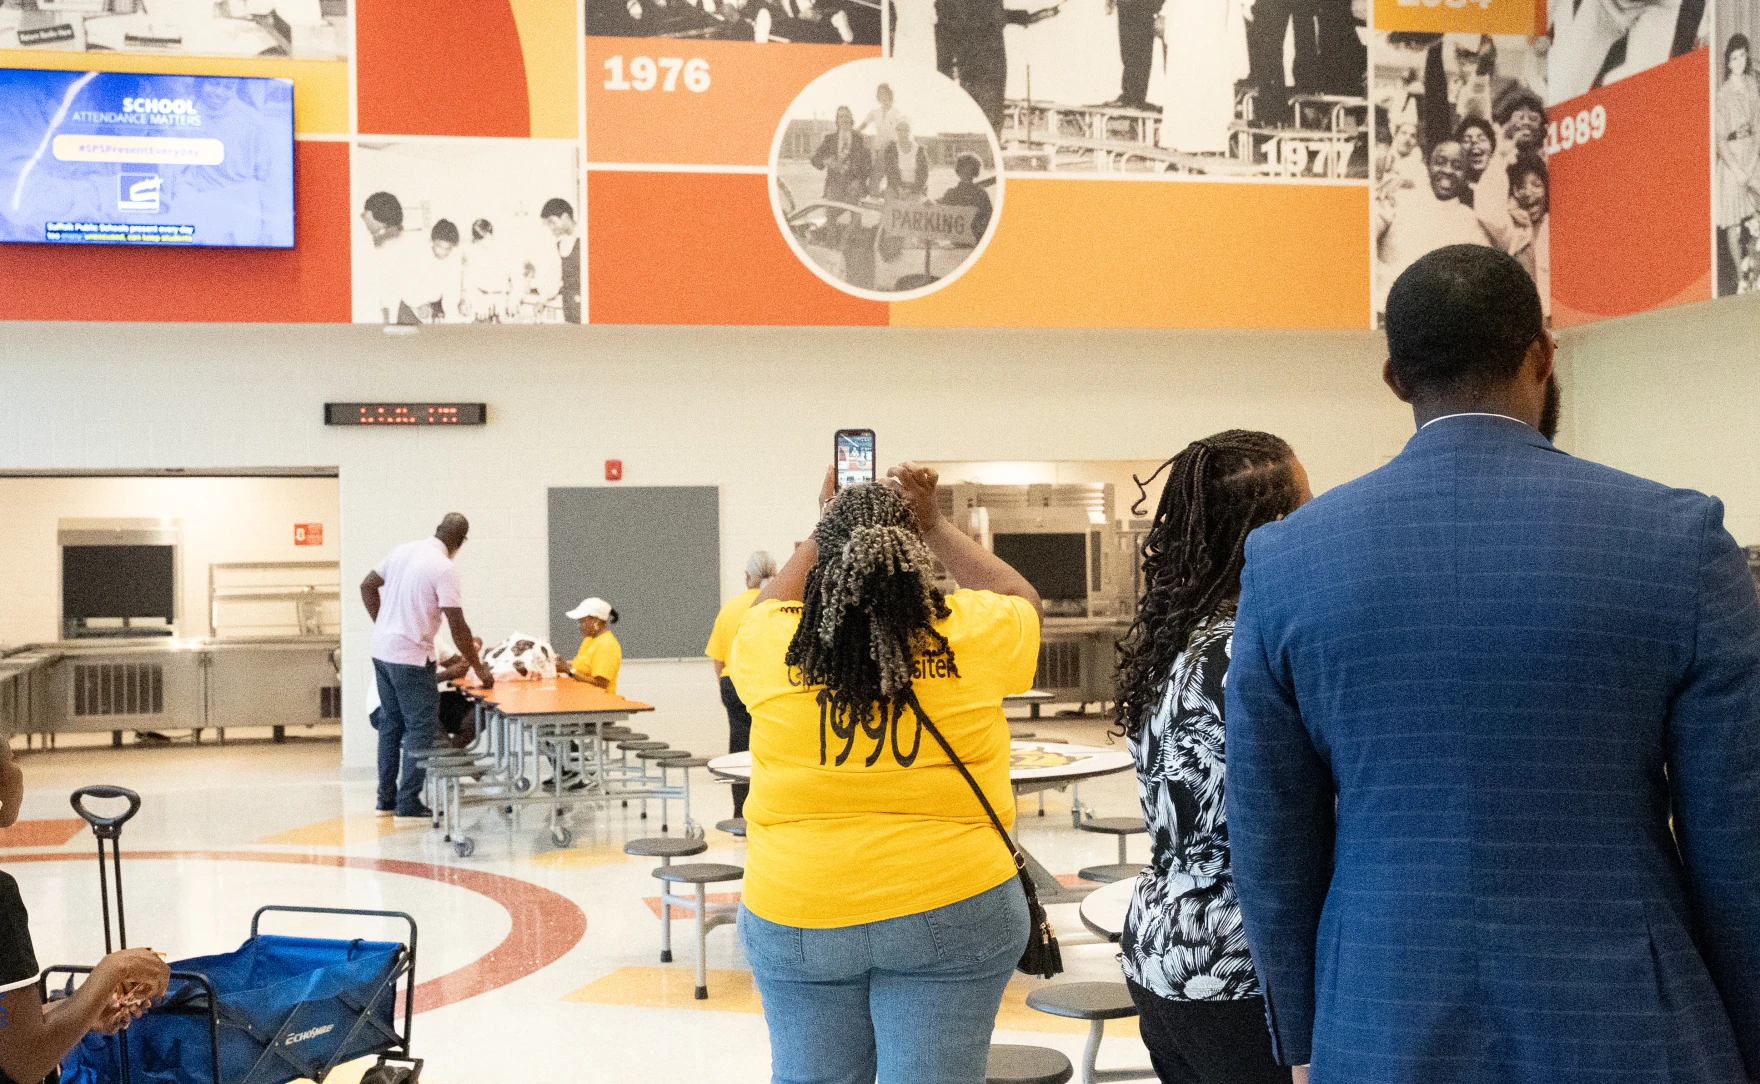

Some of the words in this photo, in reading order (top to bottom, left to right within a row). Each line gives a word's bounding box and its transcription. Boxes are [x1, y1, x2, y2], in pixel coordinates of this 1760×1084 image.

[603, 55, 712, 93] 1976
[72, 111, 147, 124] ATTENDANCE
[149, 113, 202, 126] MATTERS
[122, 97, 198, 115] SCHOOL
[1544, 104, 1607, 156] 1989
[1260, 136, 1355, 175] 1977
[891, 208, 966, 235] PARKING
[815, 689, 923, 768] 1990
